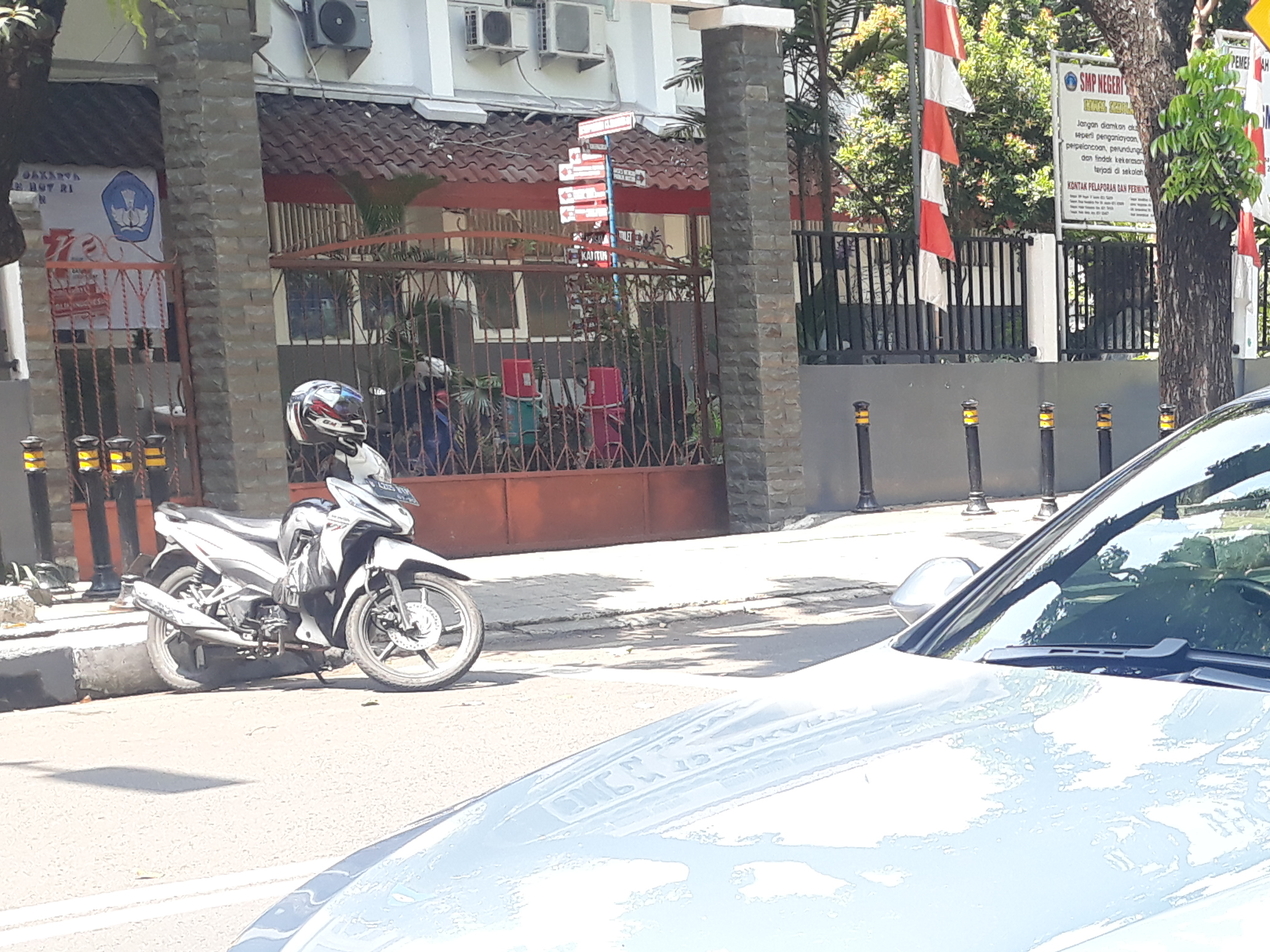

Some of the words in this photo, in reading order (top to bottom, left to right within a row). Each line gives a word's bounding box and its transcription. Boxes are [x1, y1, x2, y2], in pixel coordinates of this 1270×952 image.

[1080, 71, 1096, 93] SMP
[1077, 120, 1098, 130] Jangan
[1101, 122, 1126, 130] diamkan
[1067, 181, 1088, 191] KONTAK
[1088, 182, 1116, 193] PELAPORAN
[1117, 184, 1127, 193] DAN
